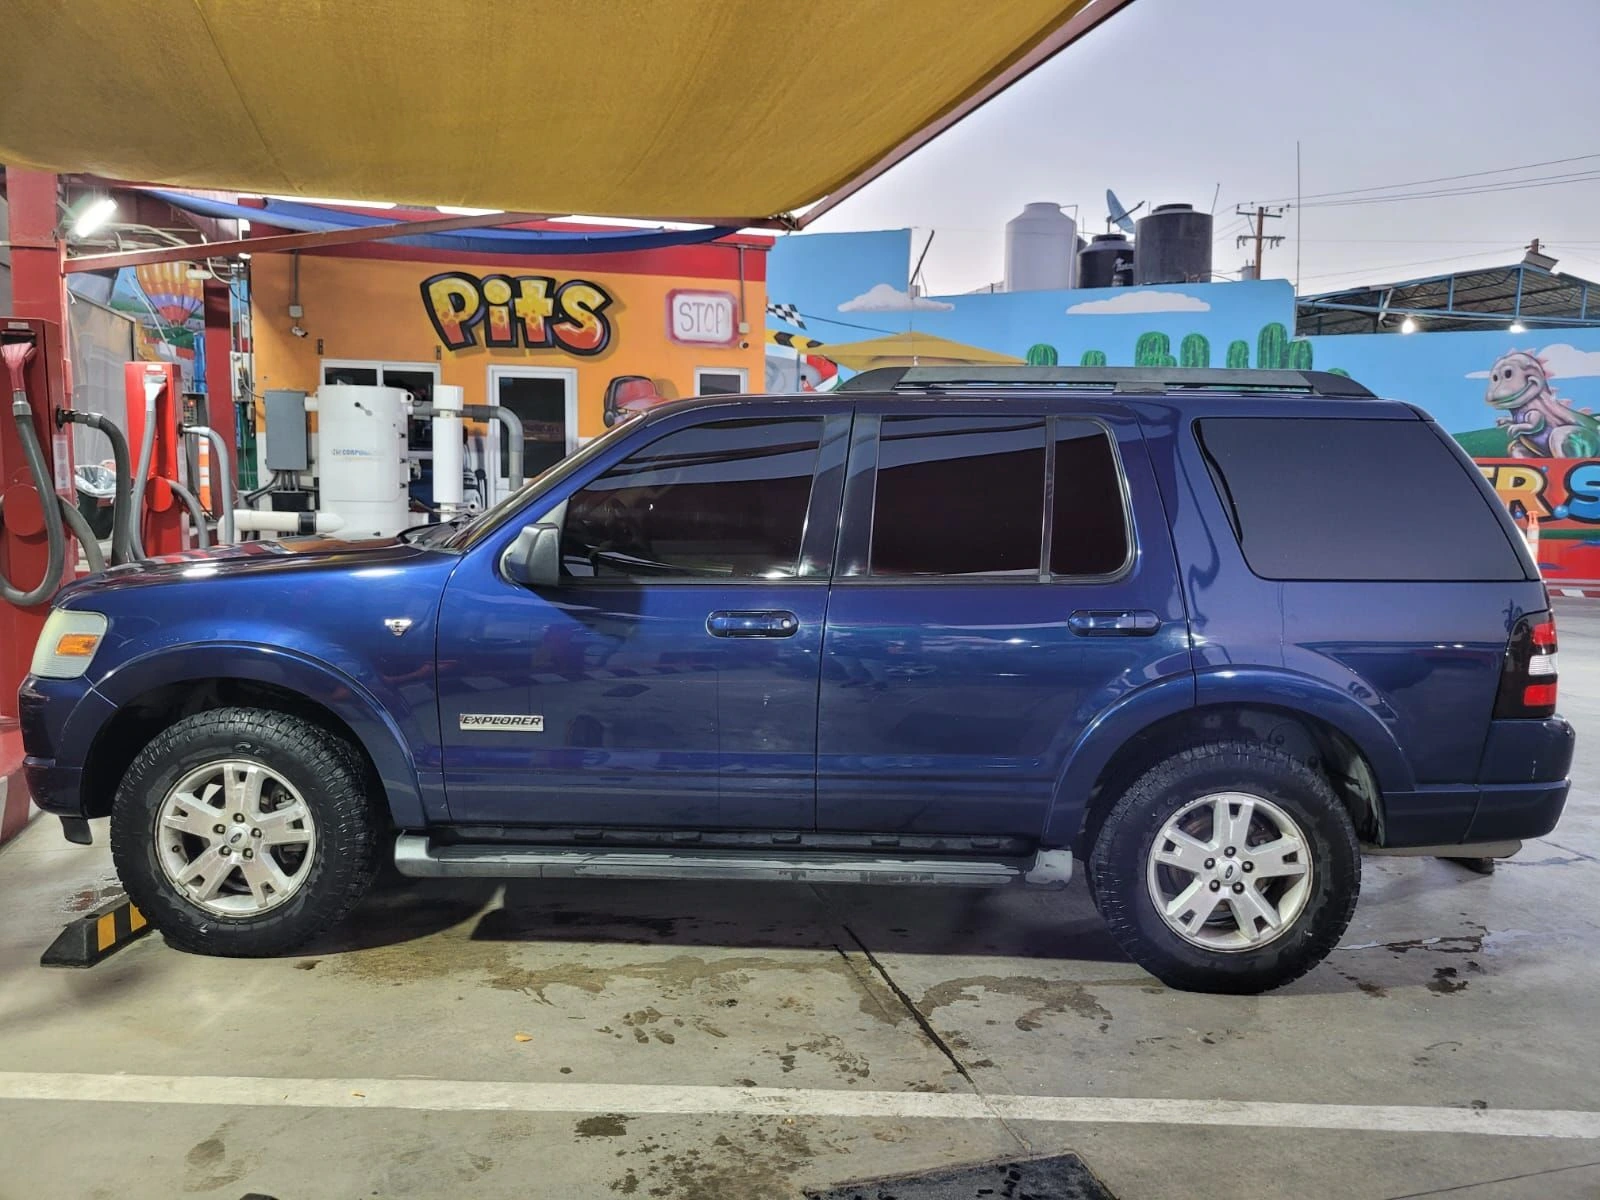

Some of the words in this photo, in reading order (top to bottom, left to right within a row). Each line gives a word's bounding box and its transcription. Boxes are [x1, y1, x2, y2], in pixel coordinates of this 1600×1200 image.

[679, 302, 725, 334] STOP
[1478, 464, 1551, 522] R
[462, 716, 541, 725] EXPLORER
